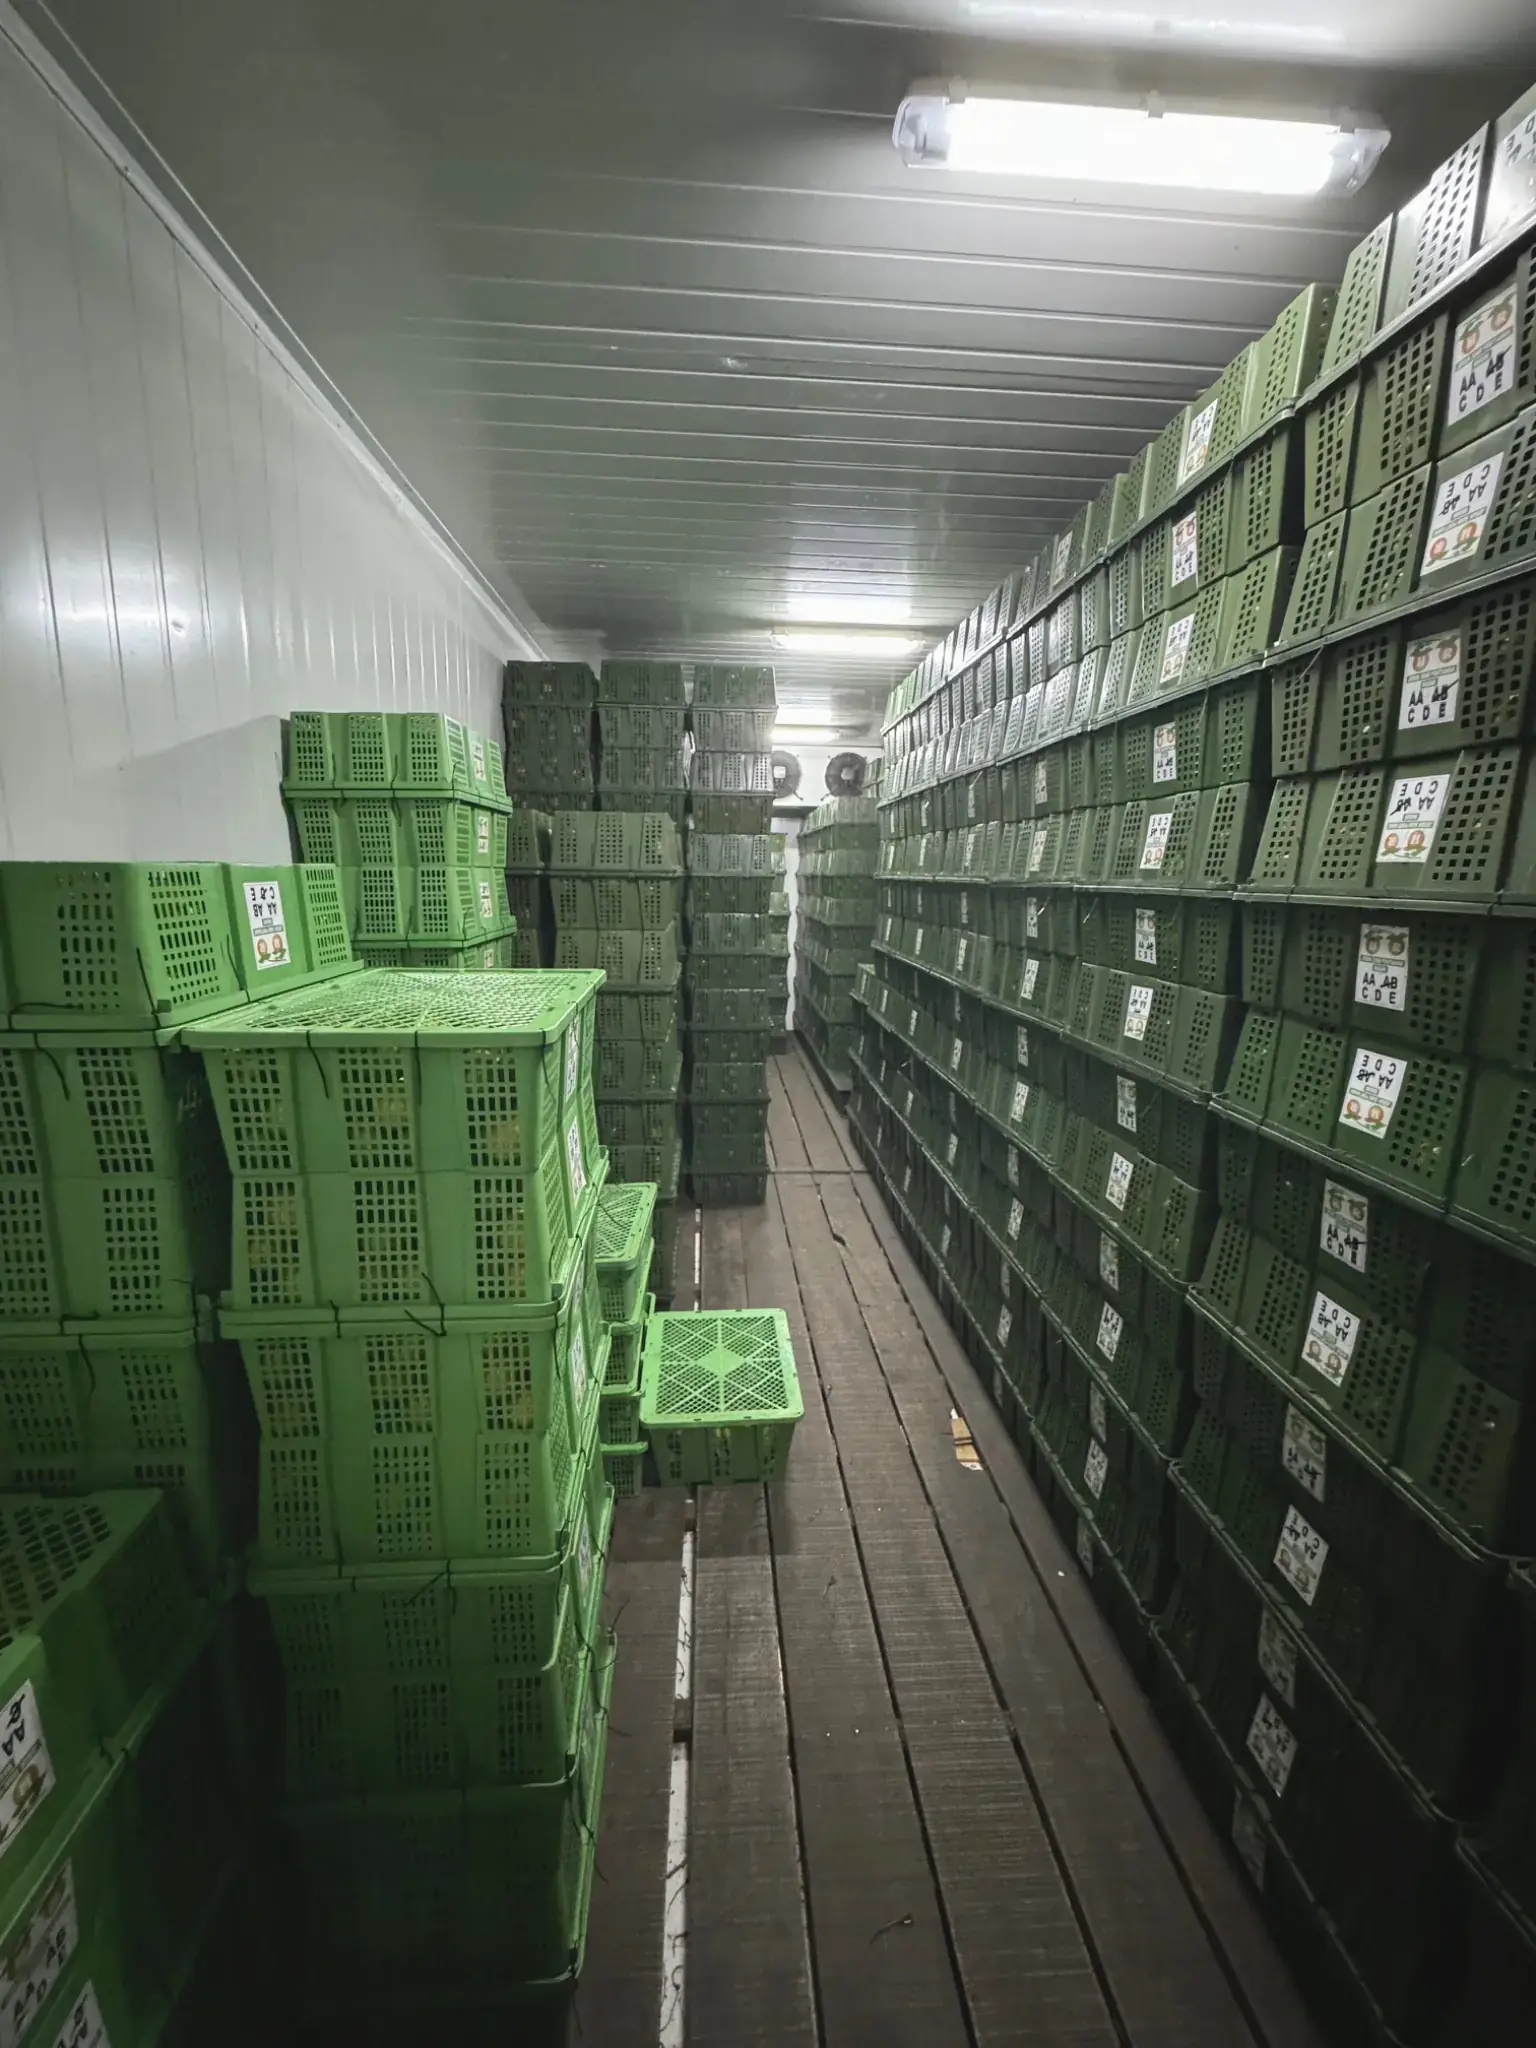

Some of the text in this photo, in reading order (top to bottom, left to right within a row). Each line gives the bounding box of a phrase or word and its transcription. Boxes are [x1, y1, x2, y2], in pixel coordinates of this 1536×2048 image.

[1459, 371, 1503, 412] C D E
[1460, 372, 1476, 395] AA
[1447, 464, 1490, 498] C D E
[1469, 482, 1487, 502] AA
[1409, 691, 1423, 707] AA
[1408, 702, 1446, 723] C D E
[1400, 780, 1438, 797] C D E
[1418, 796, 1435, 811] AA
[250, 887, 256, 901] E
[270, 886, 275, 899] C
[253, 902, 277, 917] AA AB
[1363, 972, 1375, 986] AA
[1362, 987, 1396, 1004] C D E
[1361, 1055, 1396, 1075] C D E
[1379, 1075, 1393, 1089] AA
